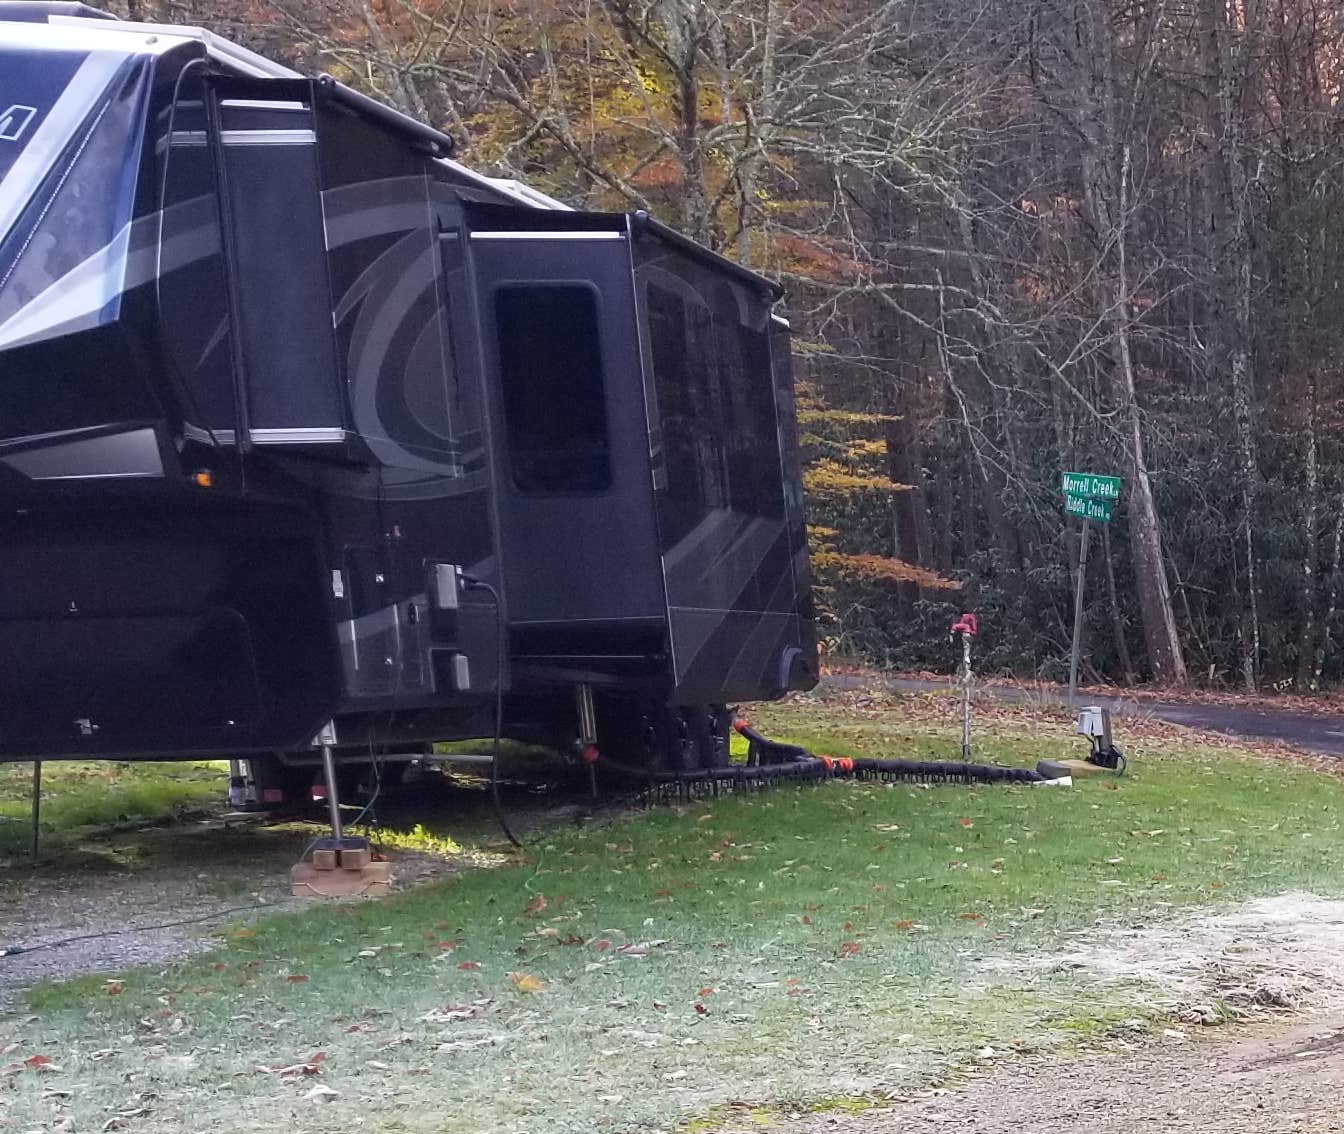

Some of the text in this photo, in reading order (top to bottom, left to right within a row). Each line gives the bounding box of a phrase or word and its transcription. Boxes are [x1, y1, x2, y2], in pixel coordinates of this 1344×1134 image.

[1063, 475, 1089, 492] Morrell
[1092, 478, 1113, 495] Creek
[1087, 499, 1104, 518] Creek
